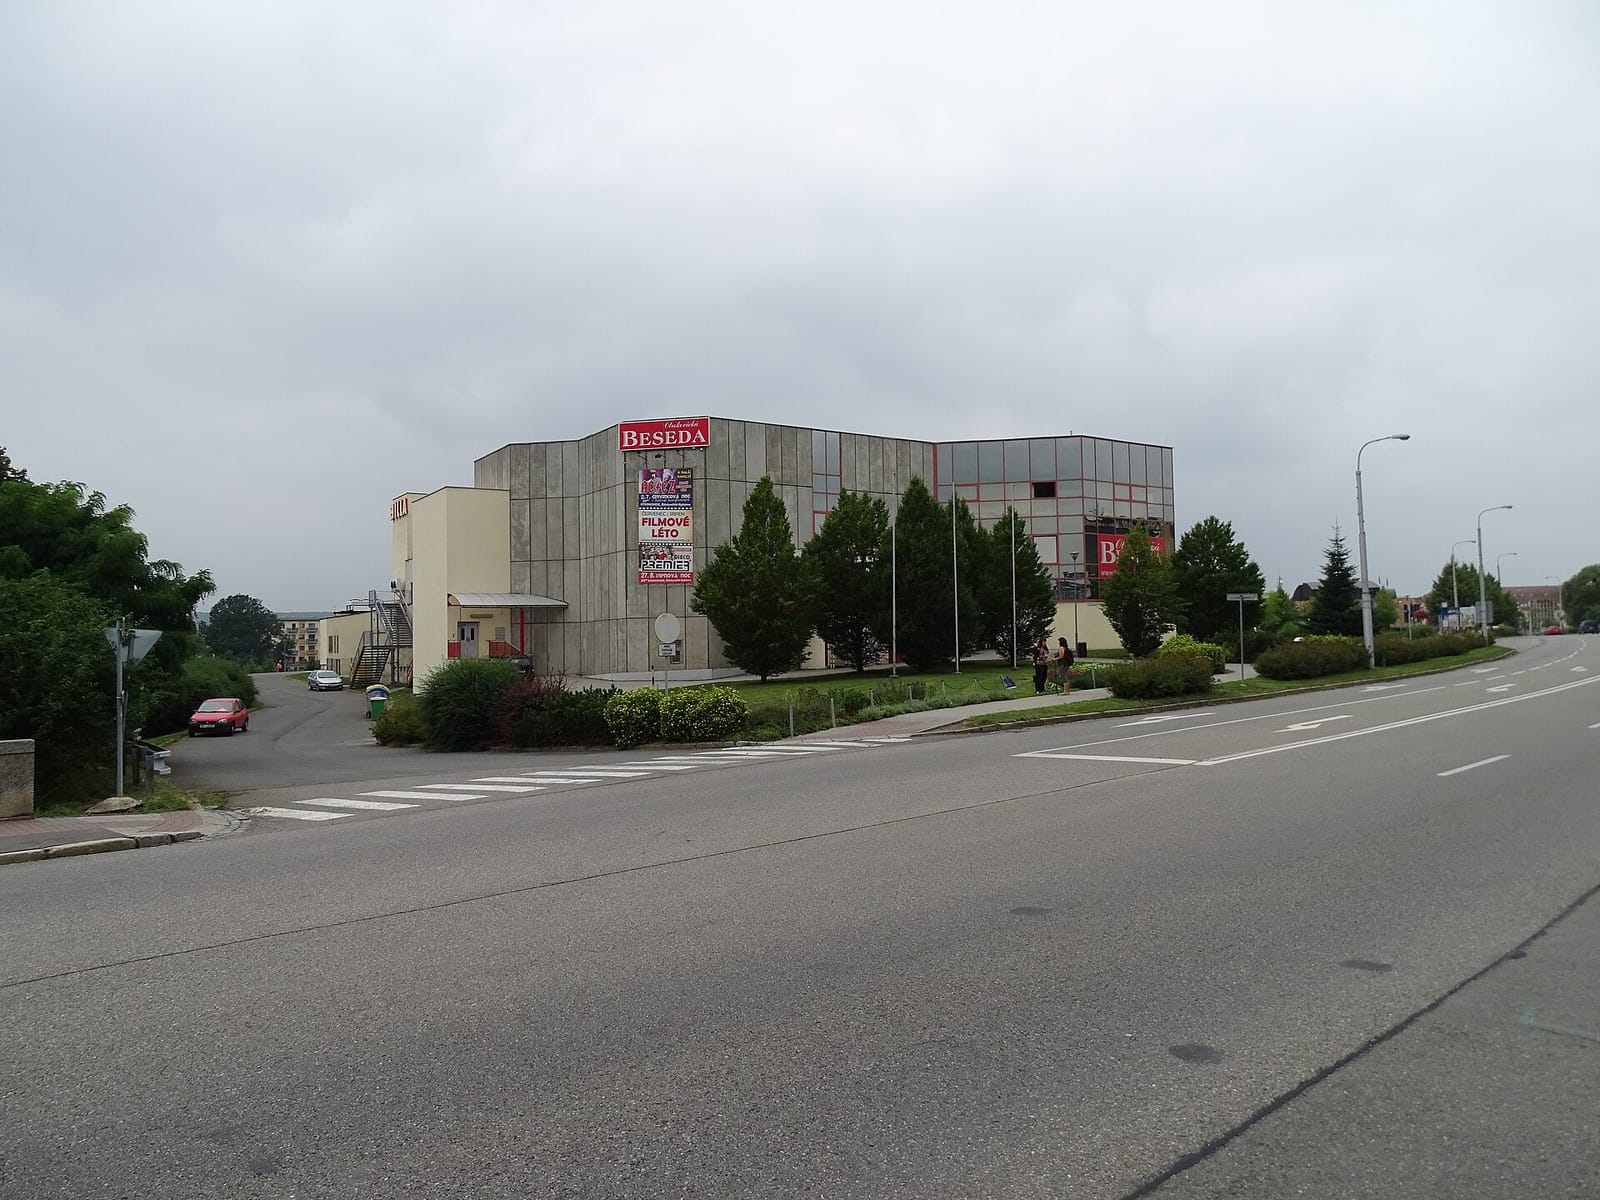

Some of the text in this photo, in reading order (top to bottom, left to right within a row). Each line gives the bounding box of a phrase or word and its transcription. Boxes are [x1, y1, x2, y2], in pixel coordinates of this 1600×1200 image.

[622, 430, 706, 447] BESEDA
[641, 516, 690, 527] FILMOVÉ
[651, 527, 679, 538] LÉTO
[642, 560, 690, 571] PREMIER
